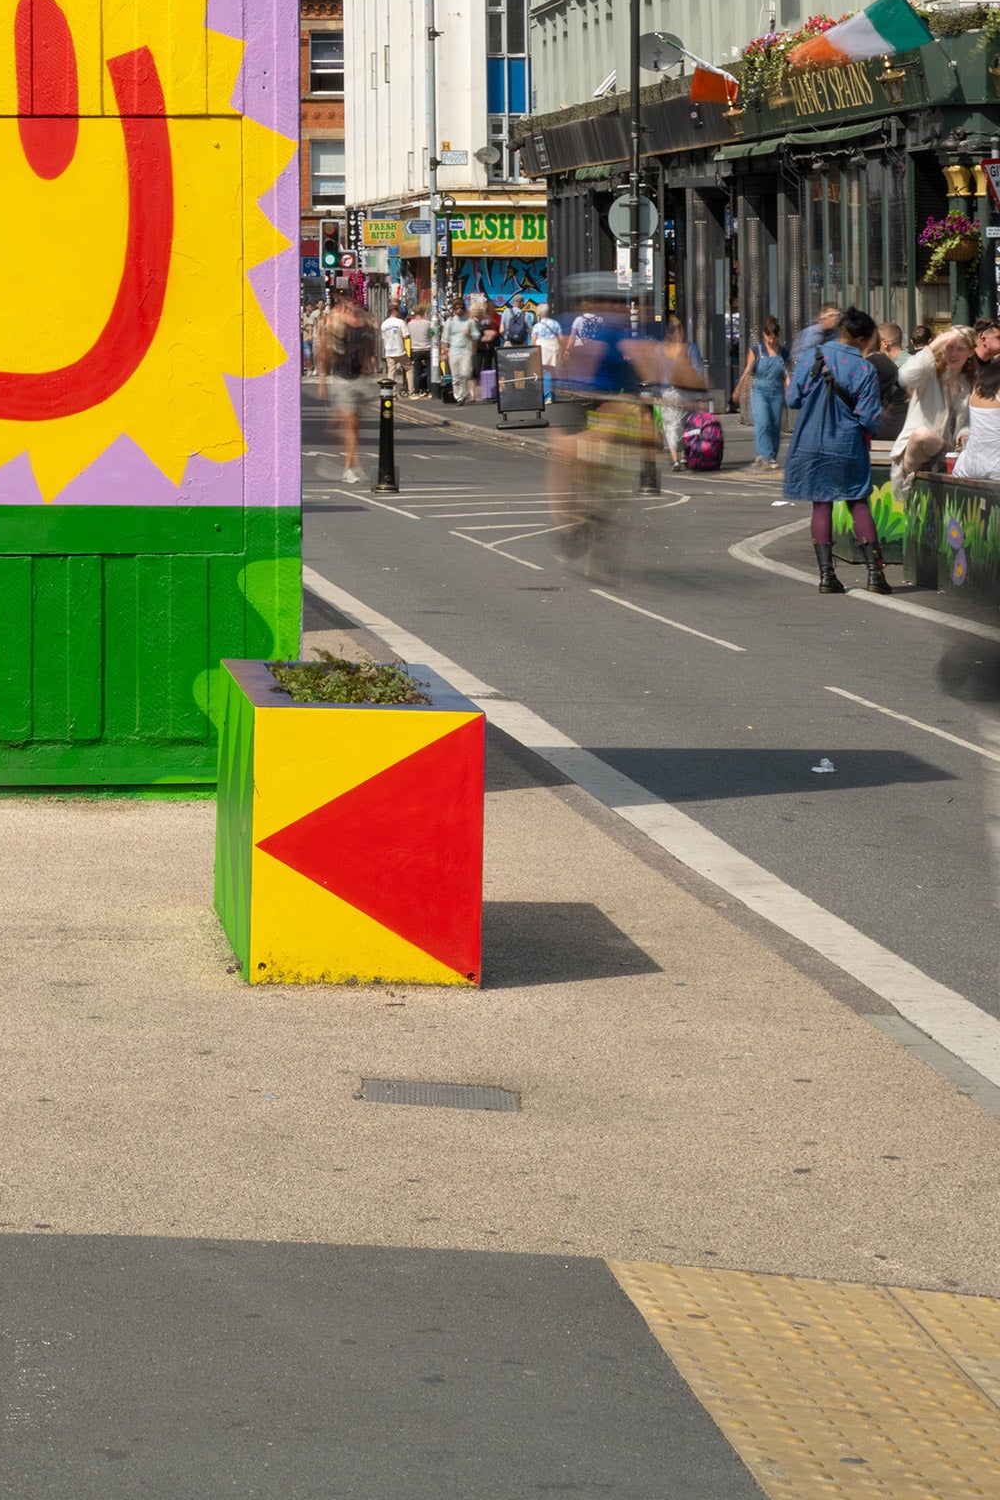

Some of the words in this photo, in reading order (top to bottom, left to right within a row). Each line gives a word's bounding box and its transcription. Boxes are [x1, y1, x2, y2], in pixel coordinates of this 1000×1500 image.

[788, 69, 832, 116] NANCY
[827, 61, 873, 110] SPAINS
[369, 222, 397, 231] FRESH
[370, 231, 396, 240] BITES
[437, 213, 516, 240] RESH
